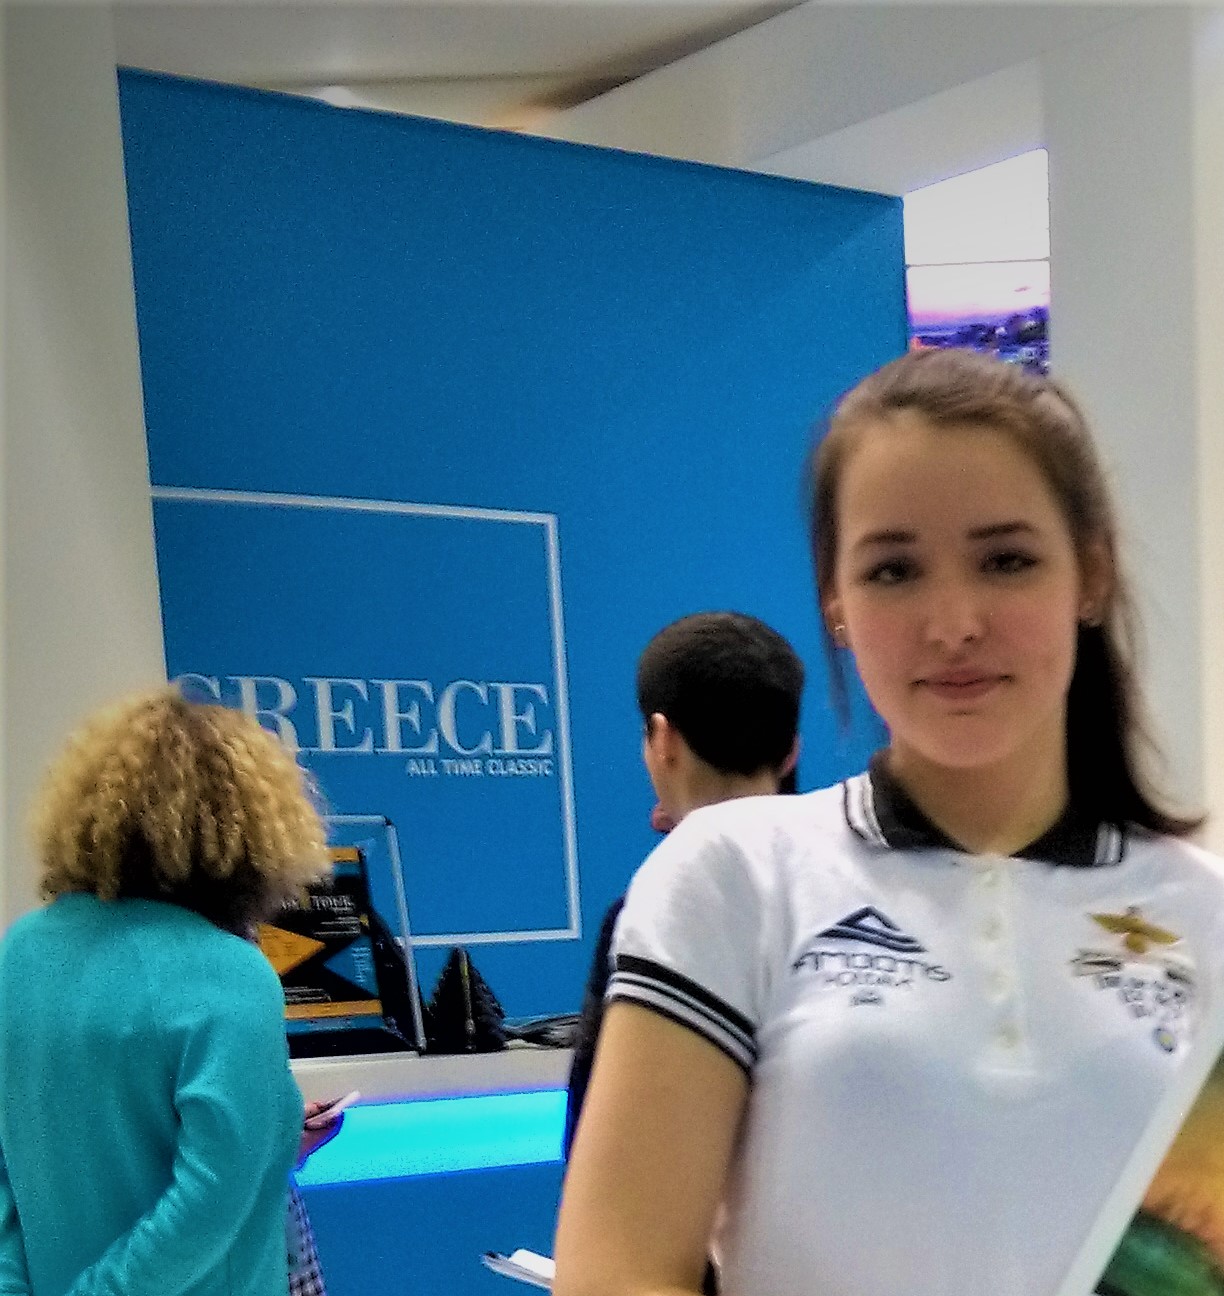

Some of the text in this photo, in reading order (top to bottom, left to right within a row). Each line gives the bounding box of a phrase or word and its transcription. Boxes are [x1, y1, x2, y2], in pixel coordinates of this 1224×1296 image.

[406, 758, 553, 777] ALL TIME CLASSIC
